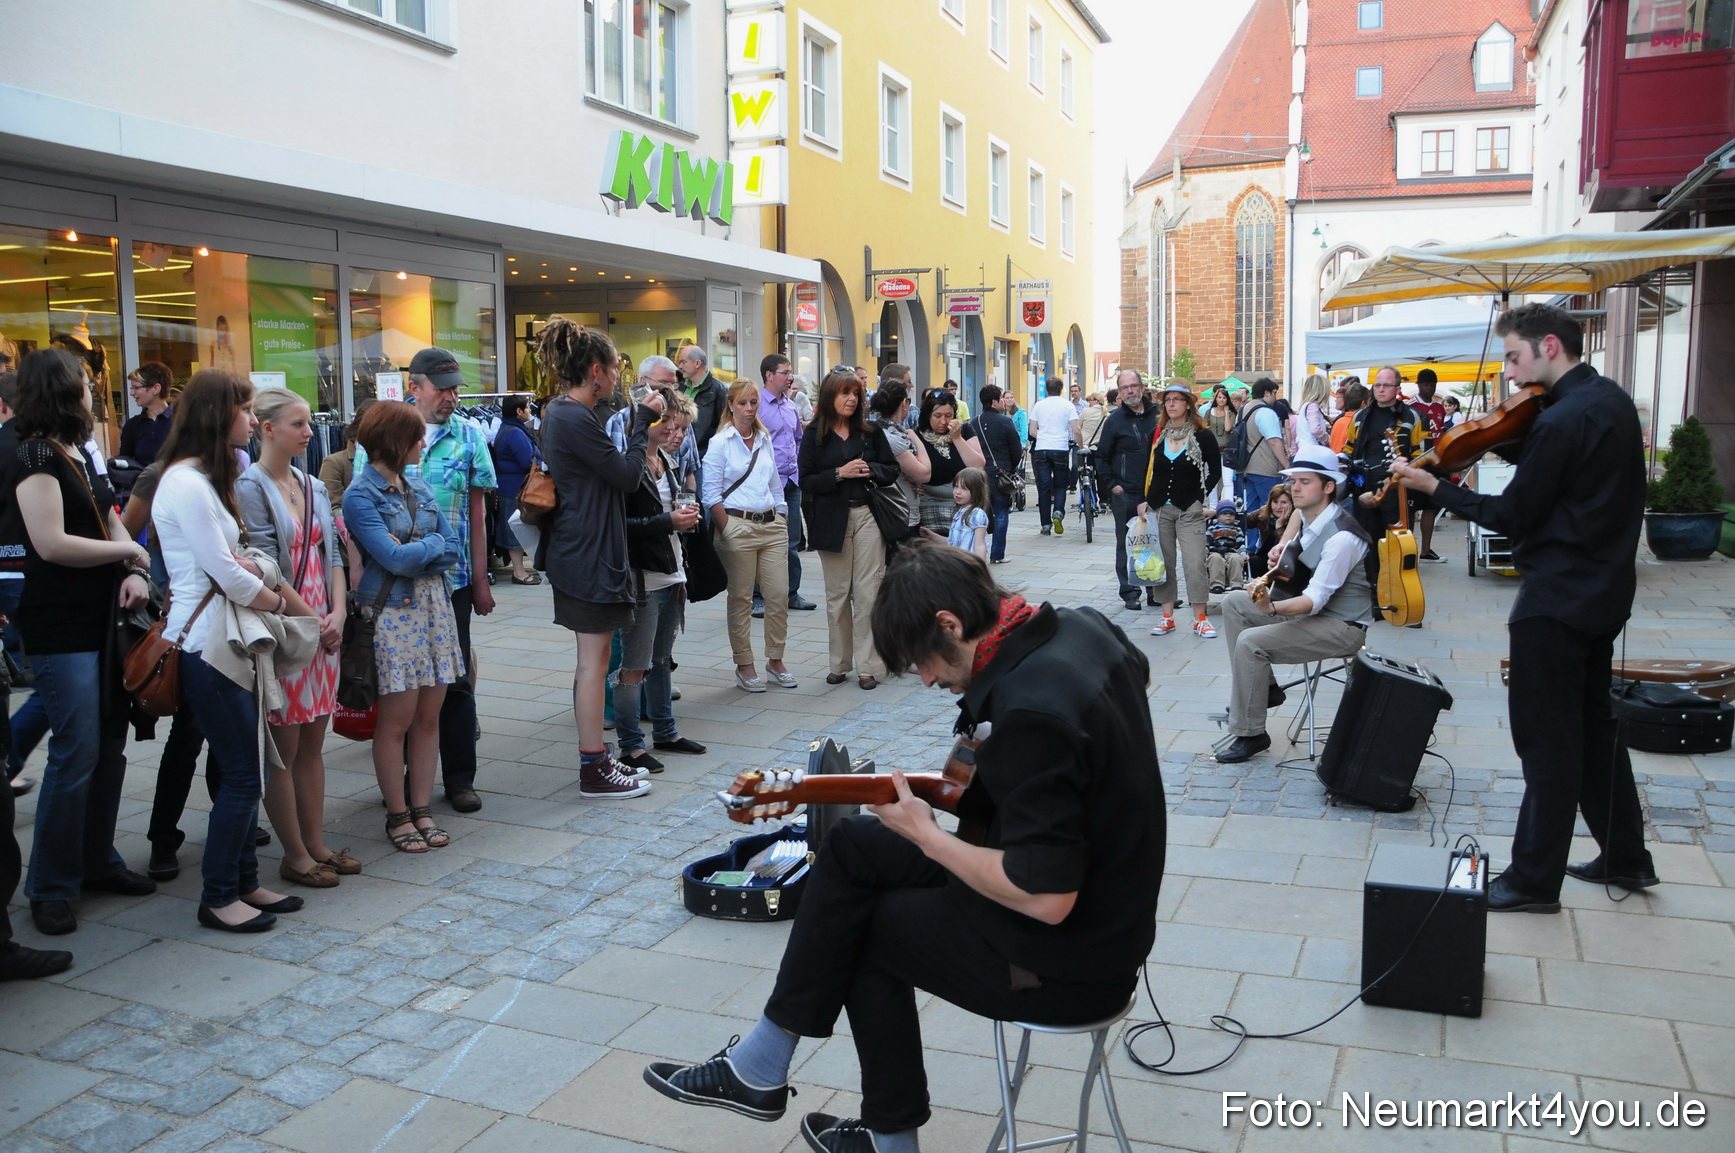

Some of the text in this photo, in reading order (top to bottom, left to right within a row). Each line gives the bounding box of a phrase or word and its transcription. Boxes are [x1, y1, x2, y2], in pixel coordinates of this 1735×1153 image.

[1651, 29, 1711, 49] Döpfer
[609, 129, 734, 226] KIWI
[1018, 282, 1045, 290] RATHAUS
[257, 319, 306, 330] starke Marken
[263, 339, 302, 350] gute Preise
